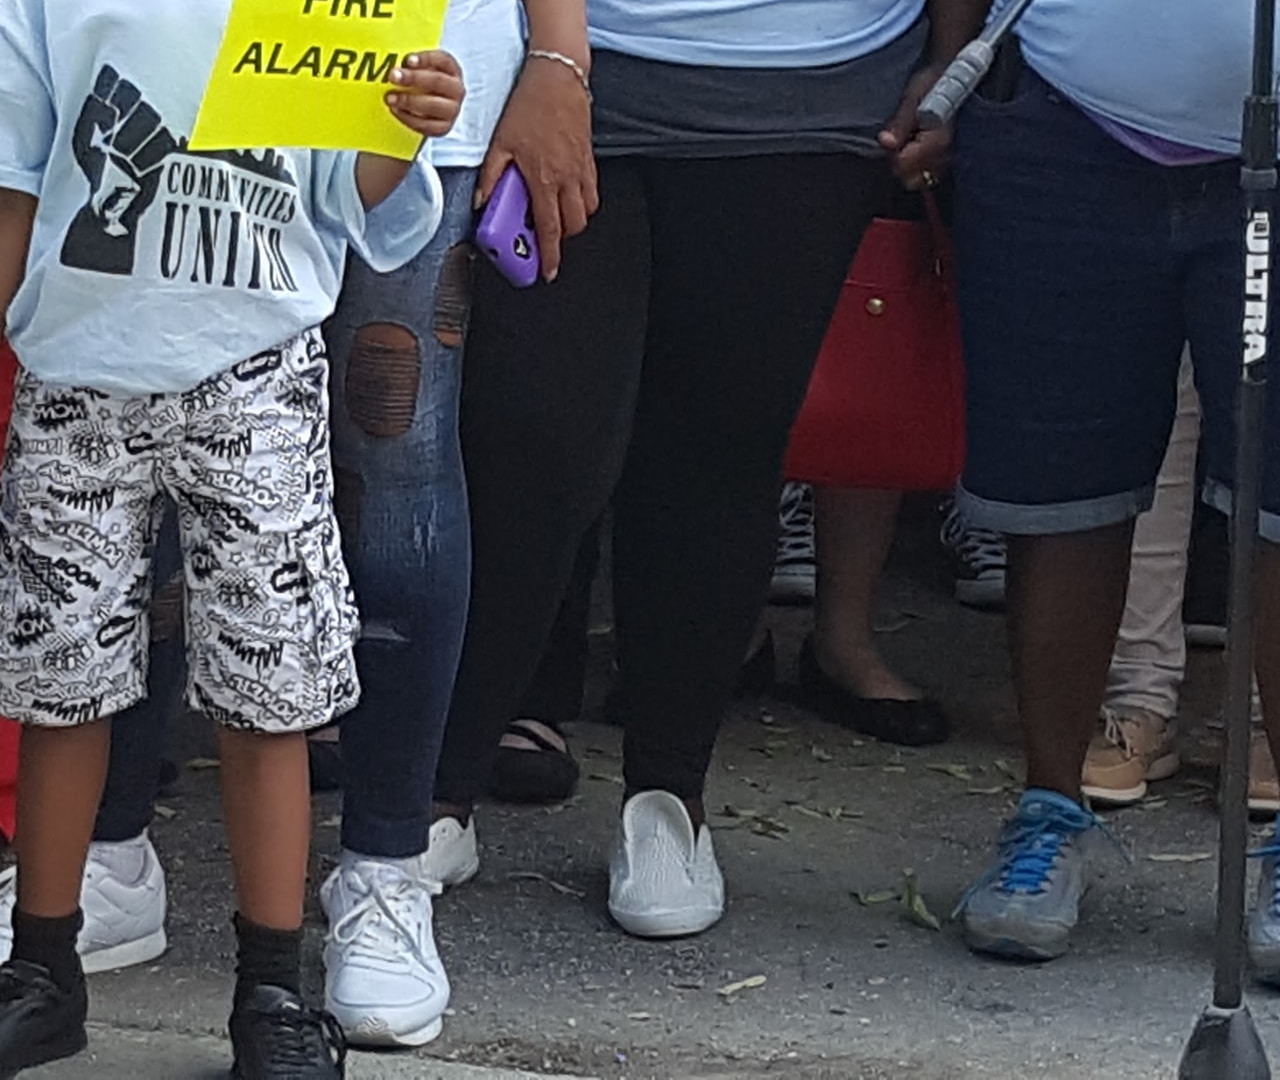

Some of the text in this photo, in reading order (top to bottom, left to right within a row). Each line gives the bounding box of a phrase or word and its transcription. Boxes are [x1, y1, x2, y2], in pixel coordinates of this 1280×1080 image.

[232, 41, 410, 84] ALARM
[166, 161, 297, 225] COMMNITIES
[1243, 219, 1270, 366] ULTRA
